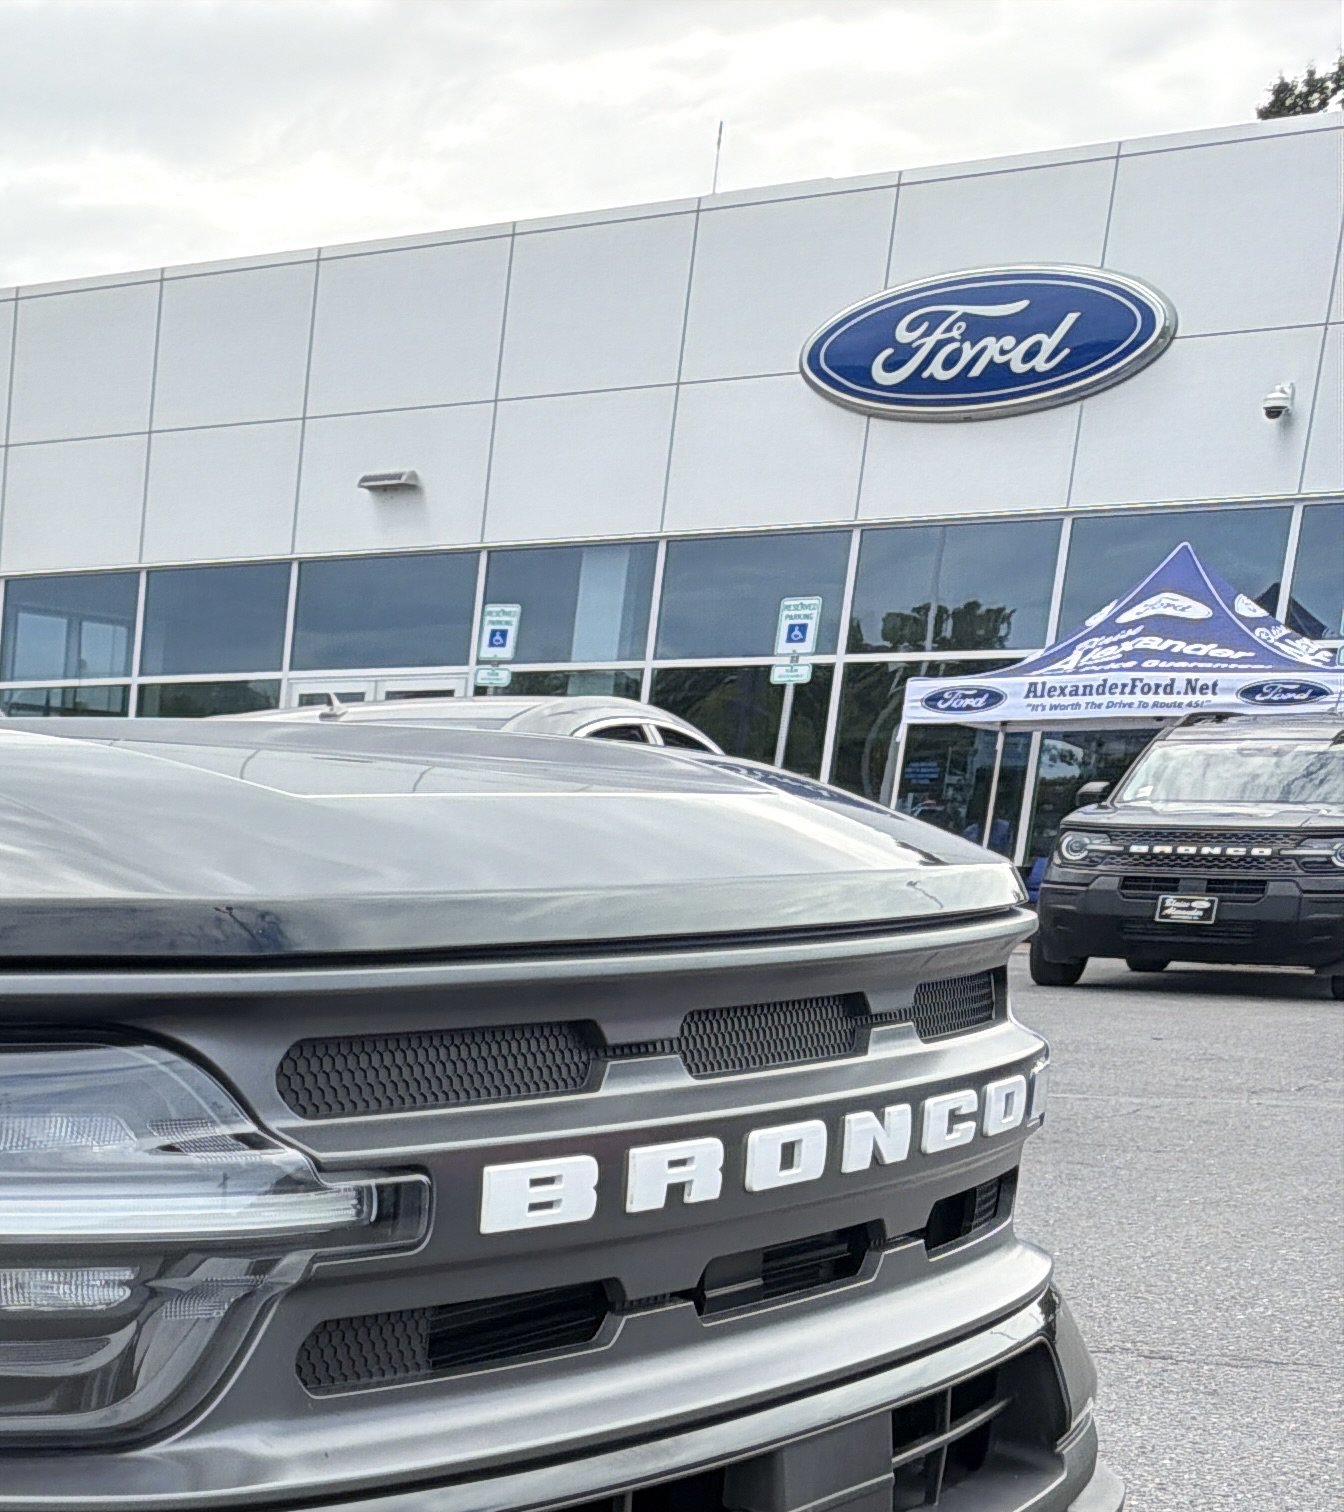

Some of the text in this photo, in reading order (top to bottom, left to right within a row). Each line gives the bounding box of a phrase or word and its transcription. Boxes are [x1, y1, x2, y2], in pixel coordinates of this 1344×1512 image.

[870, 298, 1081, 387] Ford
[937, 687, 988, 709] Ford
[1024, 677, 1219, 699] AlexanderFord.Net
[1049, 702, 1081, 711] Worth
[1084, 700, 1103, 710] The
[1105, 700, 1135, 709] Drive
[1137, 700, 1150, 709] To
[1150, 700, 1184, 709] Route
[1129, 844, 1273, 856] BRONCO
[478, 1073, 1027, 1235] BRONCO
